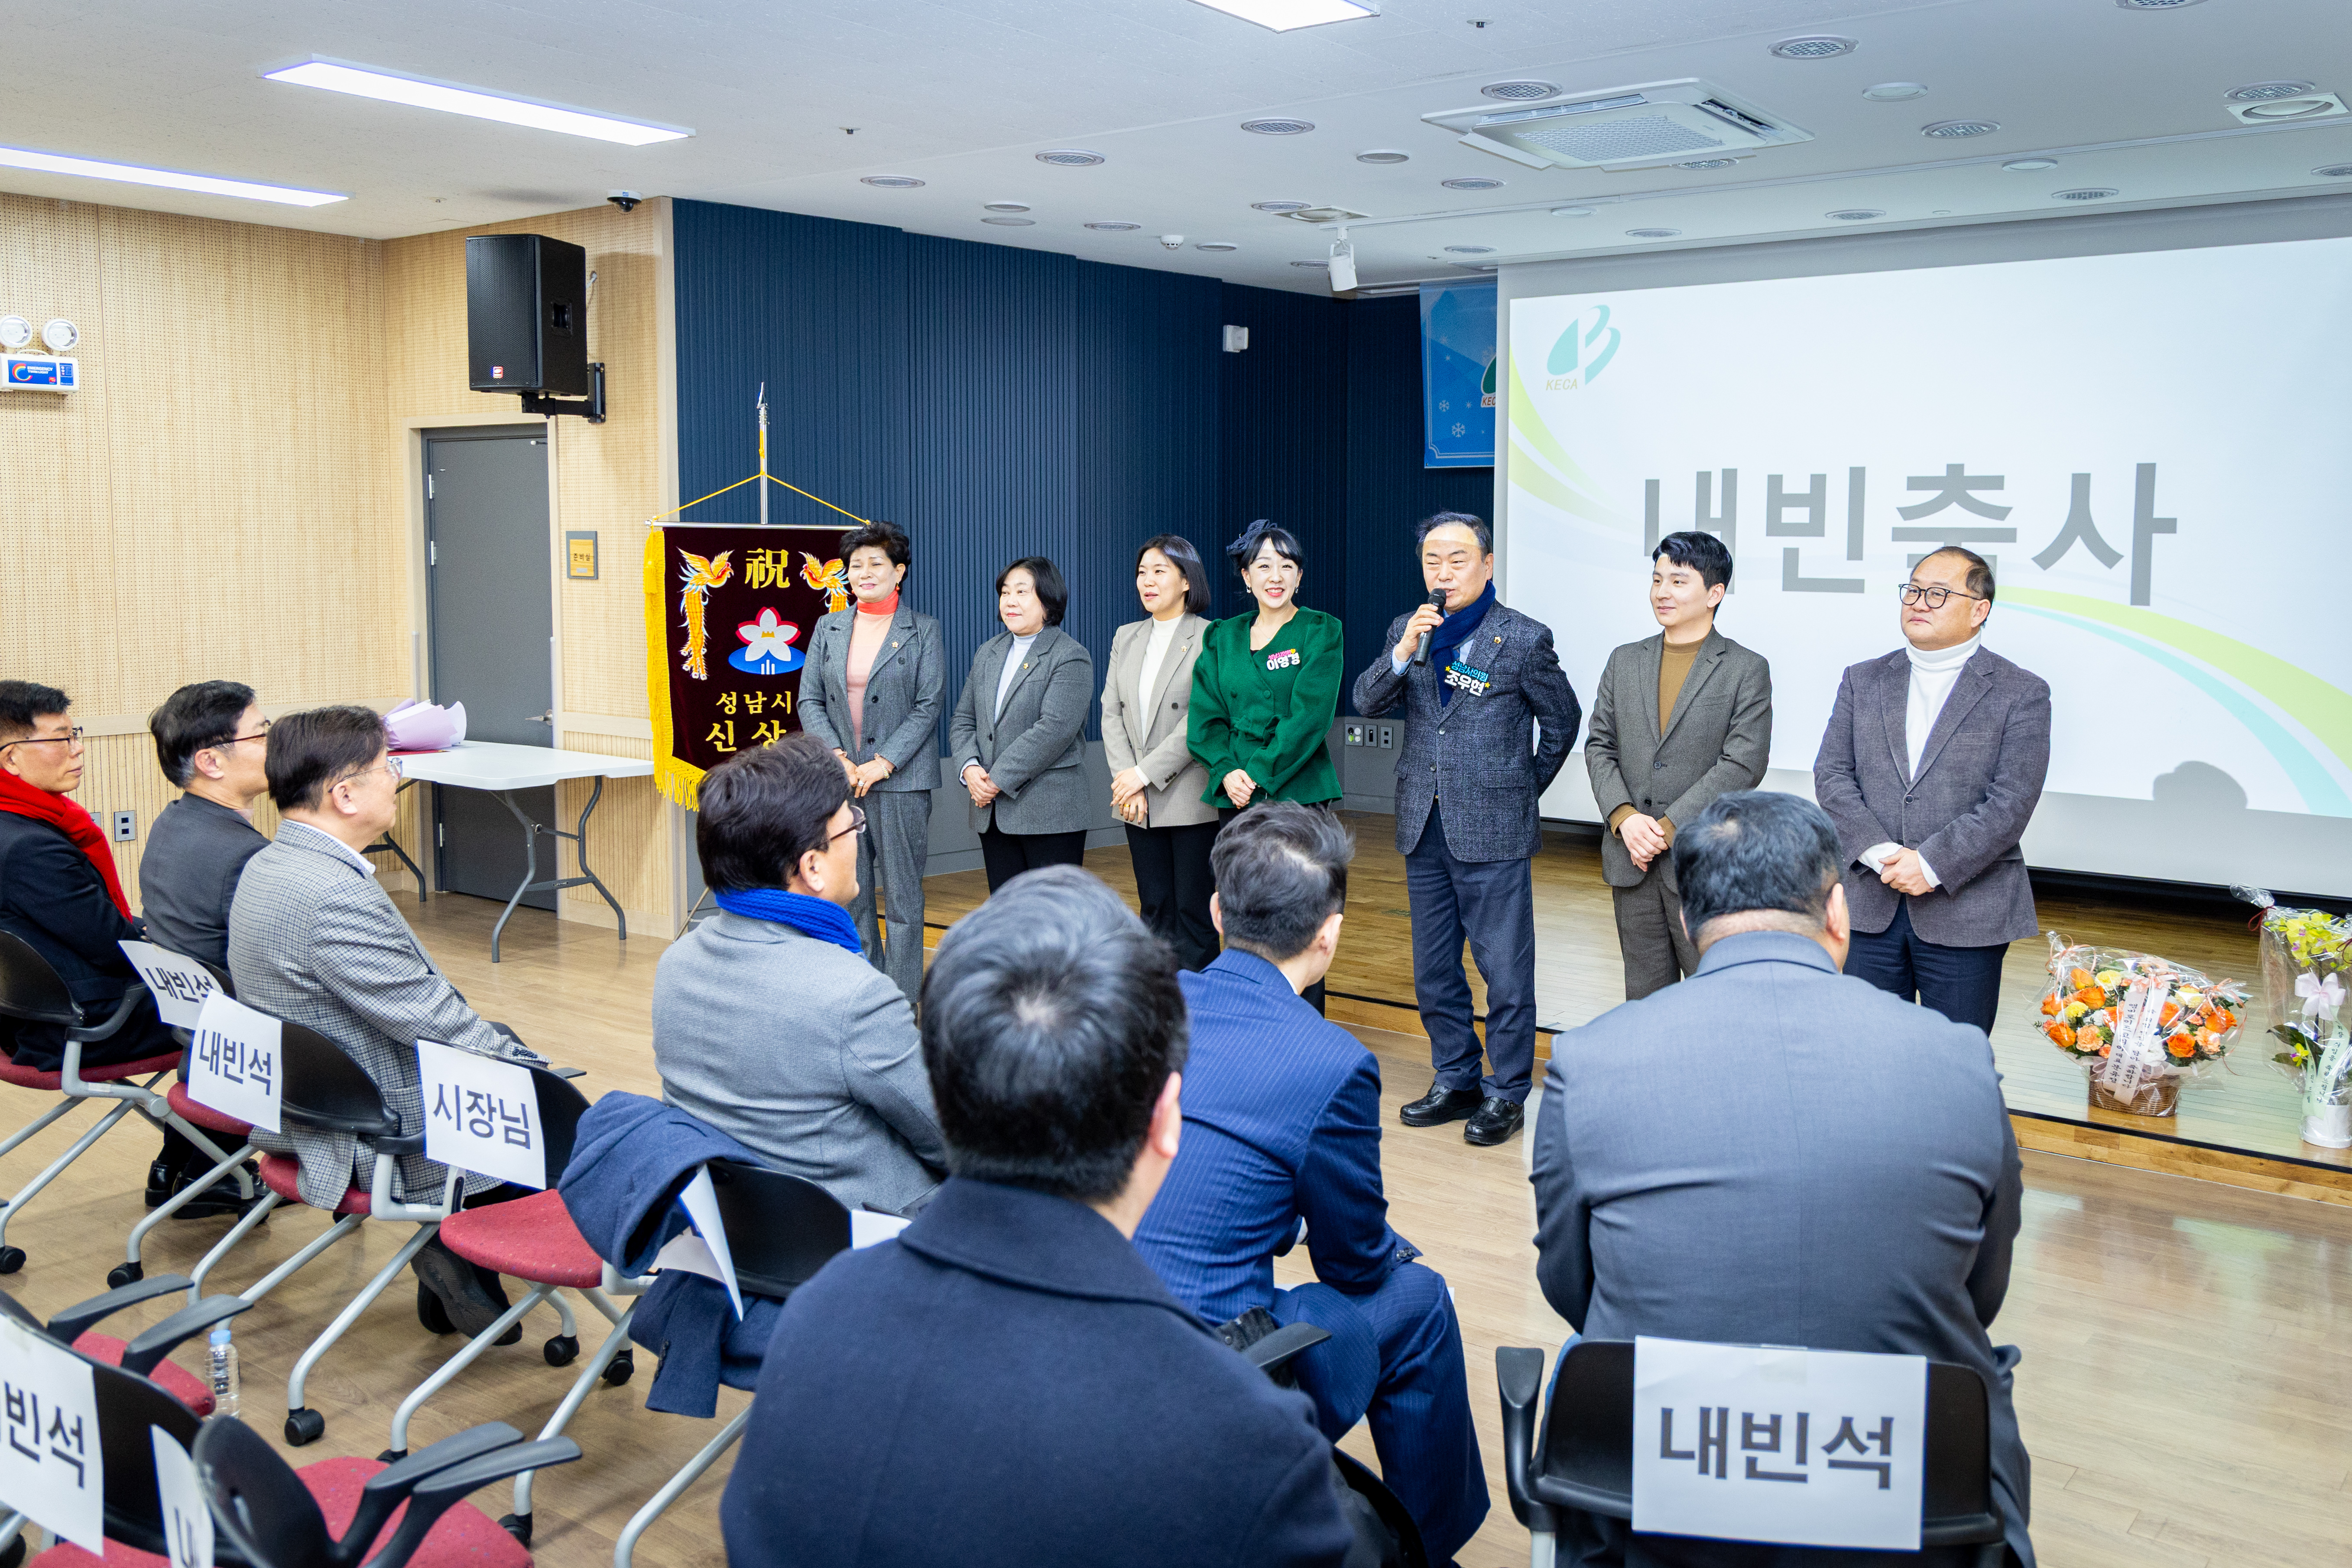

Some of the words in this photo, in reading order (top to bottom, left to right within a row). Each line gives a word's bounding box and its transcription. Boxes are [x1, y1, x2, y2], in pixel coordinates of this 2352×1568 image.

[1545, 378, 1578, 391] KECA
[573, 553, 590, 562] 준비실
[745, 547, 791, 590] 祝
[1266, 652, 1301, 671] 이영경
[1451, 660, 1489, 682] 성남시의원
[1444, 669, 1485, 697] 조우현
[716, 691, 792, 714] 성남시
[198, 1029, 272, 1096] 내빈석
[2122, 1064, 2138, 1089] 축하합니다
[433, 1083, 531, 1150] 시장님
[0, 1381, 84, 1489] 빈석
[1659, 1406, 1895, 1490] 내빈석
